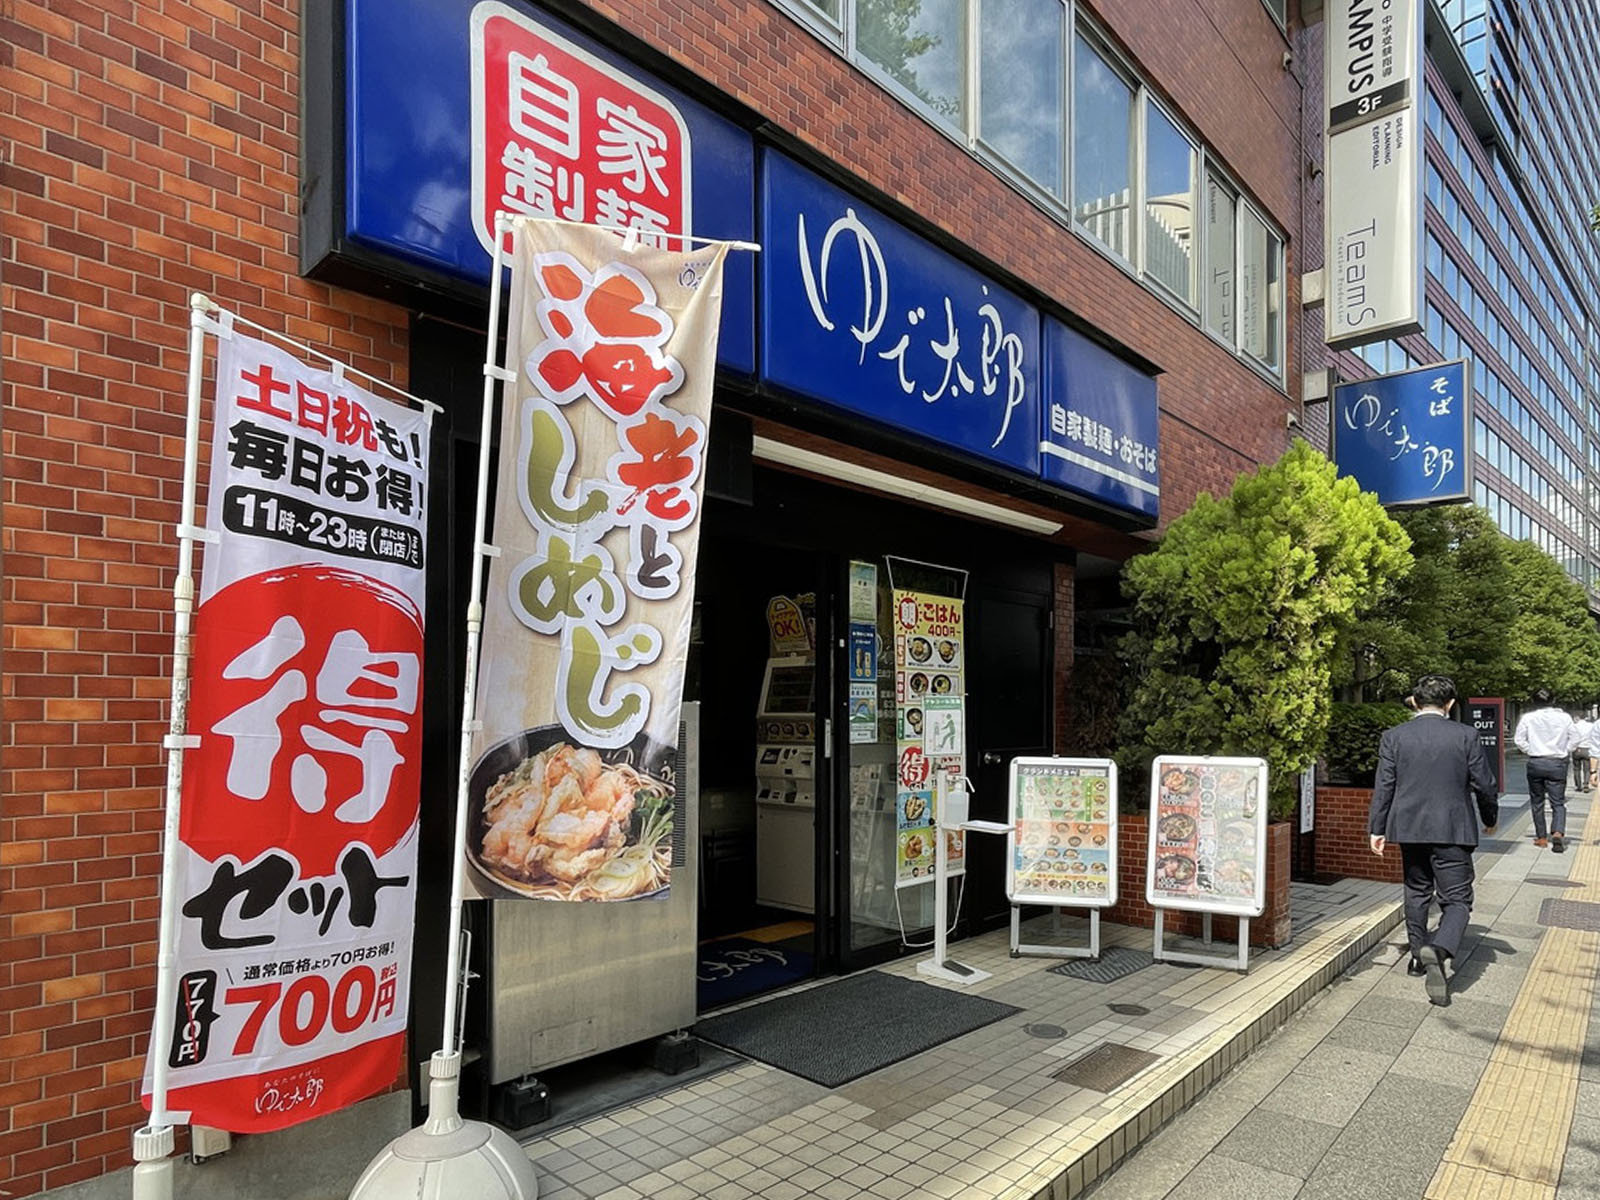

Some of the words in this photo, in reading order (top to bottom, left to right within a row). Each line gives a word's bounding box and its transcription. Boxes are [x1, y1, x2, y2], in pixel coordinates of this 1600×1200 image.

[508, 50, 668, 197] 自家
[1357, 95, 1383, 115] 3F
[1371, 125, 1381, 170] EDITORIAL
[1383, 121, 1392, 165] PLANNING
[799, 207, 1025, 449] ゆで太郎
[236, 364, 424, 471] 土日祝も!
[1050, 403, 1158, 474] 自家製麺・おそば
[1430, 376, 1454, 416] そば
[227, 418, 425, 521] 毎日お得!
[1344, 394, 1455, 493] ゆで太郎
[519, 408, 653, 735] しめじ
[210, 615, 420, 824] 得
[1473, 721, 1495, 730] OUT
[182, 847, 410, 951] セット
[243, 941, 396, 981] 通常価格より70円お得!
[176, 977, 208, 1062] 770円
[255, 1075, 325, 1114] ゆで太郎
